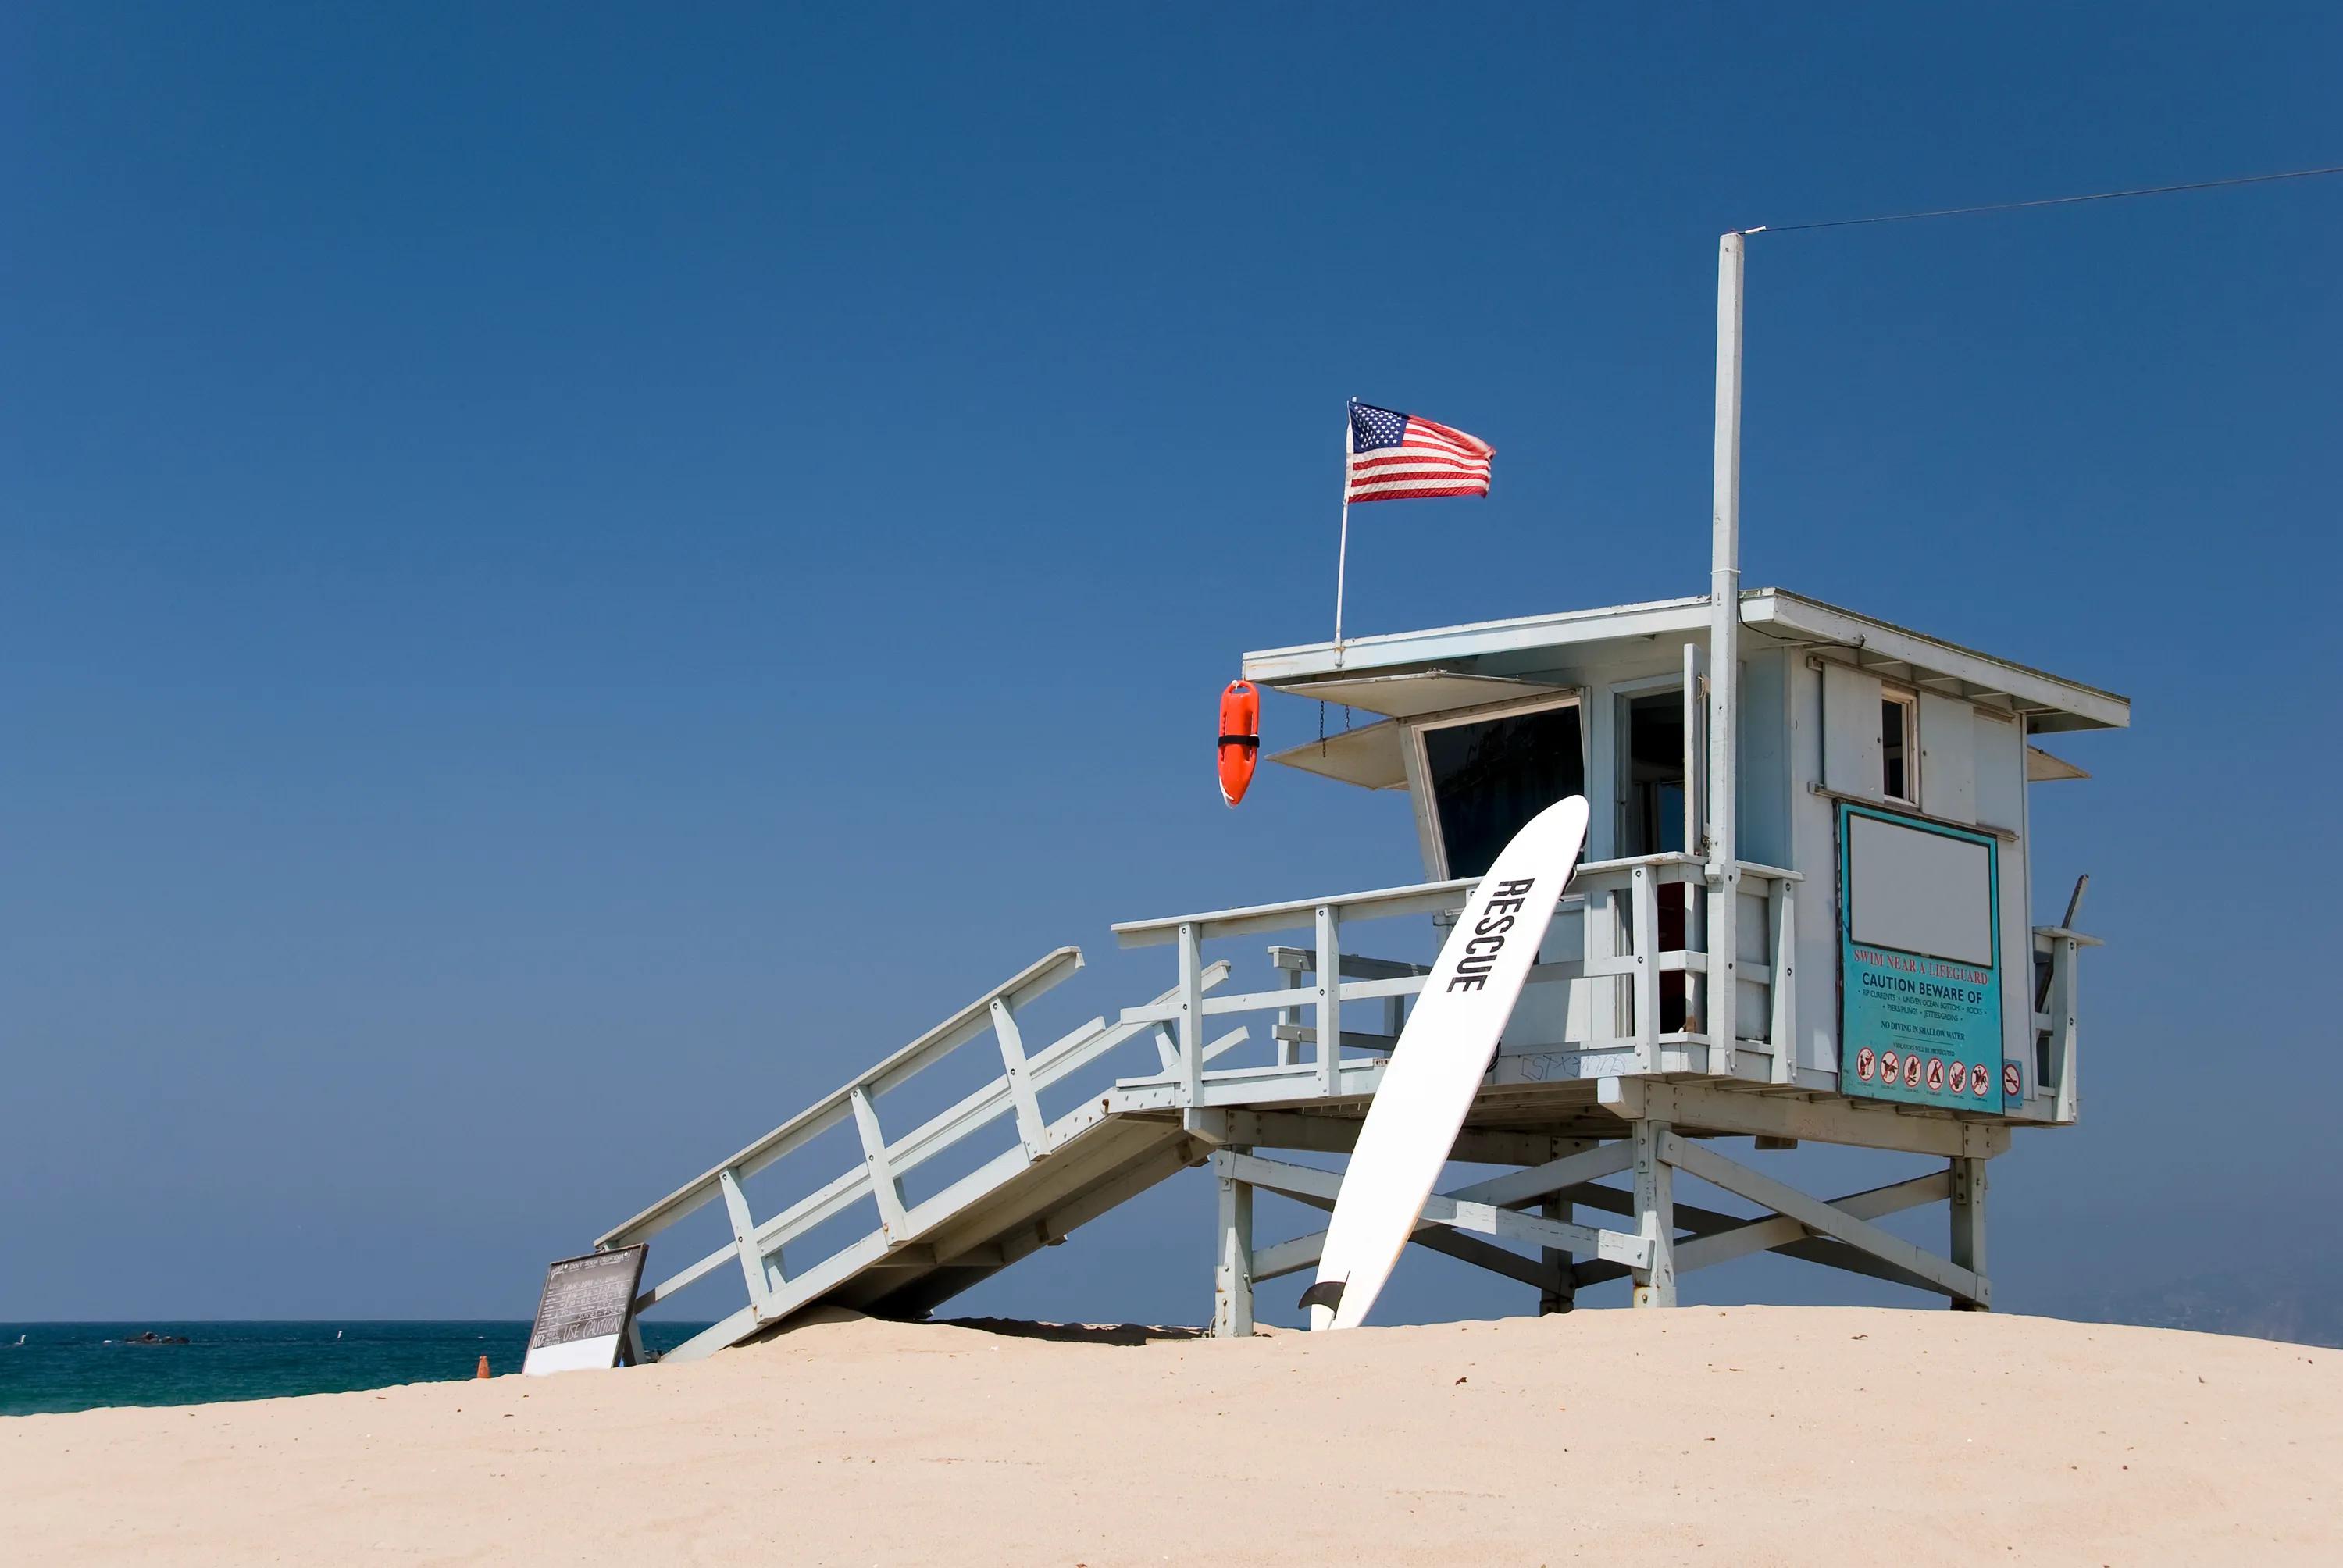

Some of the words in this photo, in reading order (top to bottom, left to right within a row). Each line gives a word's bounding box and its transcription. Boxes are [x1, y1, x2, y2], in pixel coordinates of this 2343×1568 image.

[1446, 878, 1535, 993] RESCUE
[1854, 949, 1884, 967] SWIM
[1887, 955, 1916, 973] NEAR
[1920, 961, 1925, 975] A
[1929, 962, 1988, 985] LIFEGUARD
[1862, 972, 1915, 992] CAUTION
[1919, 982, 1963, 1002] BEWARE
[1967, 990, 1982, 1004] OF
[1870, 990, 1895, 1001] CURRENTS
[1903, 996, 1921, 1006] UNEVEN
[1922, 999, 1939, 1009] OCEAN
[1940, 1001, 1960, 1011] BOTTOM
[1966, 1006, 1983, 1015] ROCKS
[1881, 1020, 1890, 1029] NO
[1891, 1021, 1911, 1032] DIVING
[1912, 1025, 1919, 1033] IN
[1919, 1026, 1945, 1039] SHALLOW
[1946, 1030, 1965, 1040] WATER
[562, 1324, 581, 1342] USE
[583, 1316, 622, 1338] CAUTION
